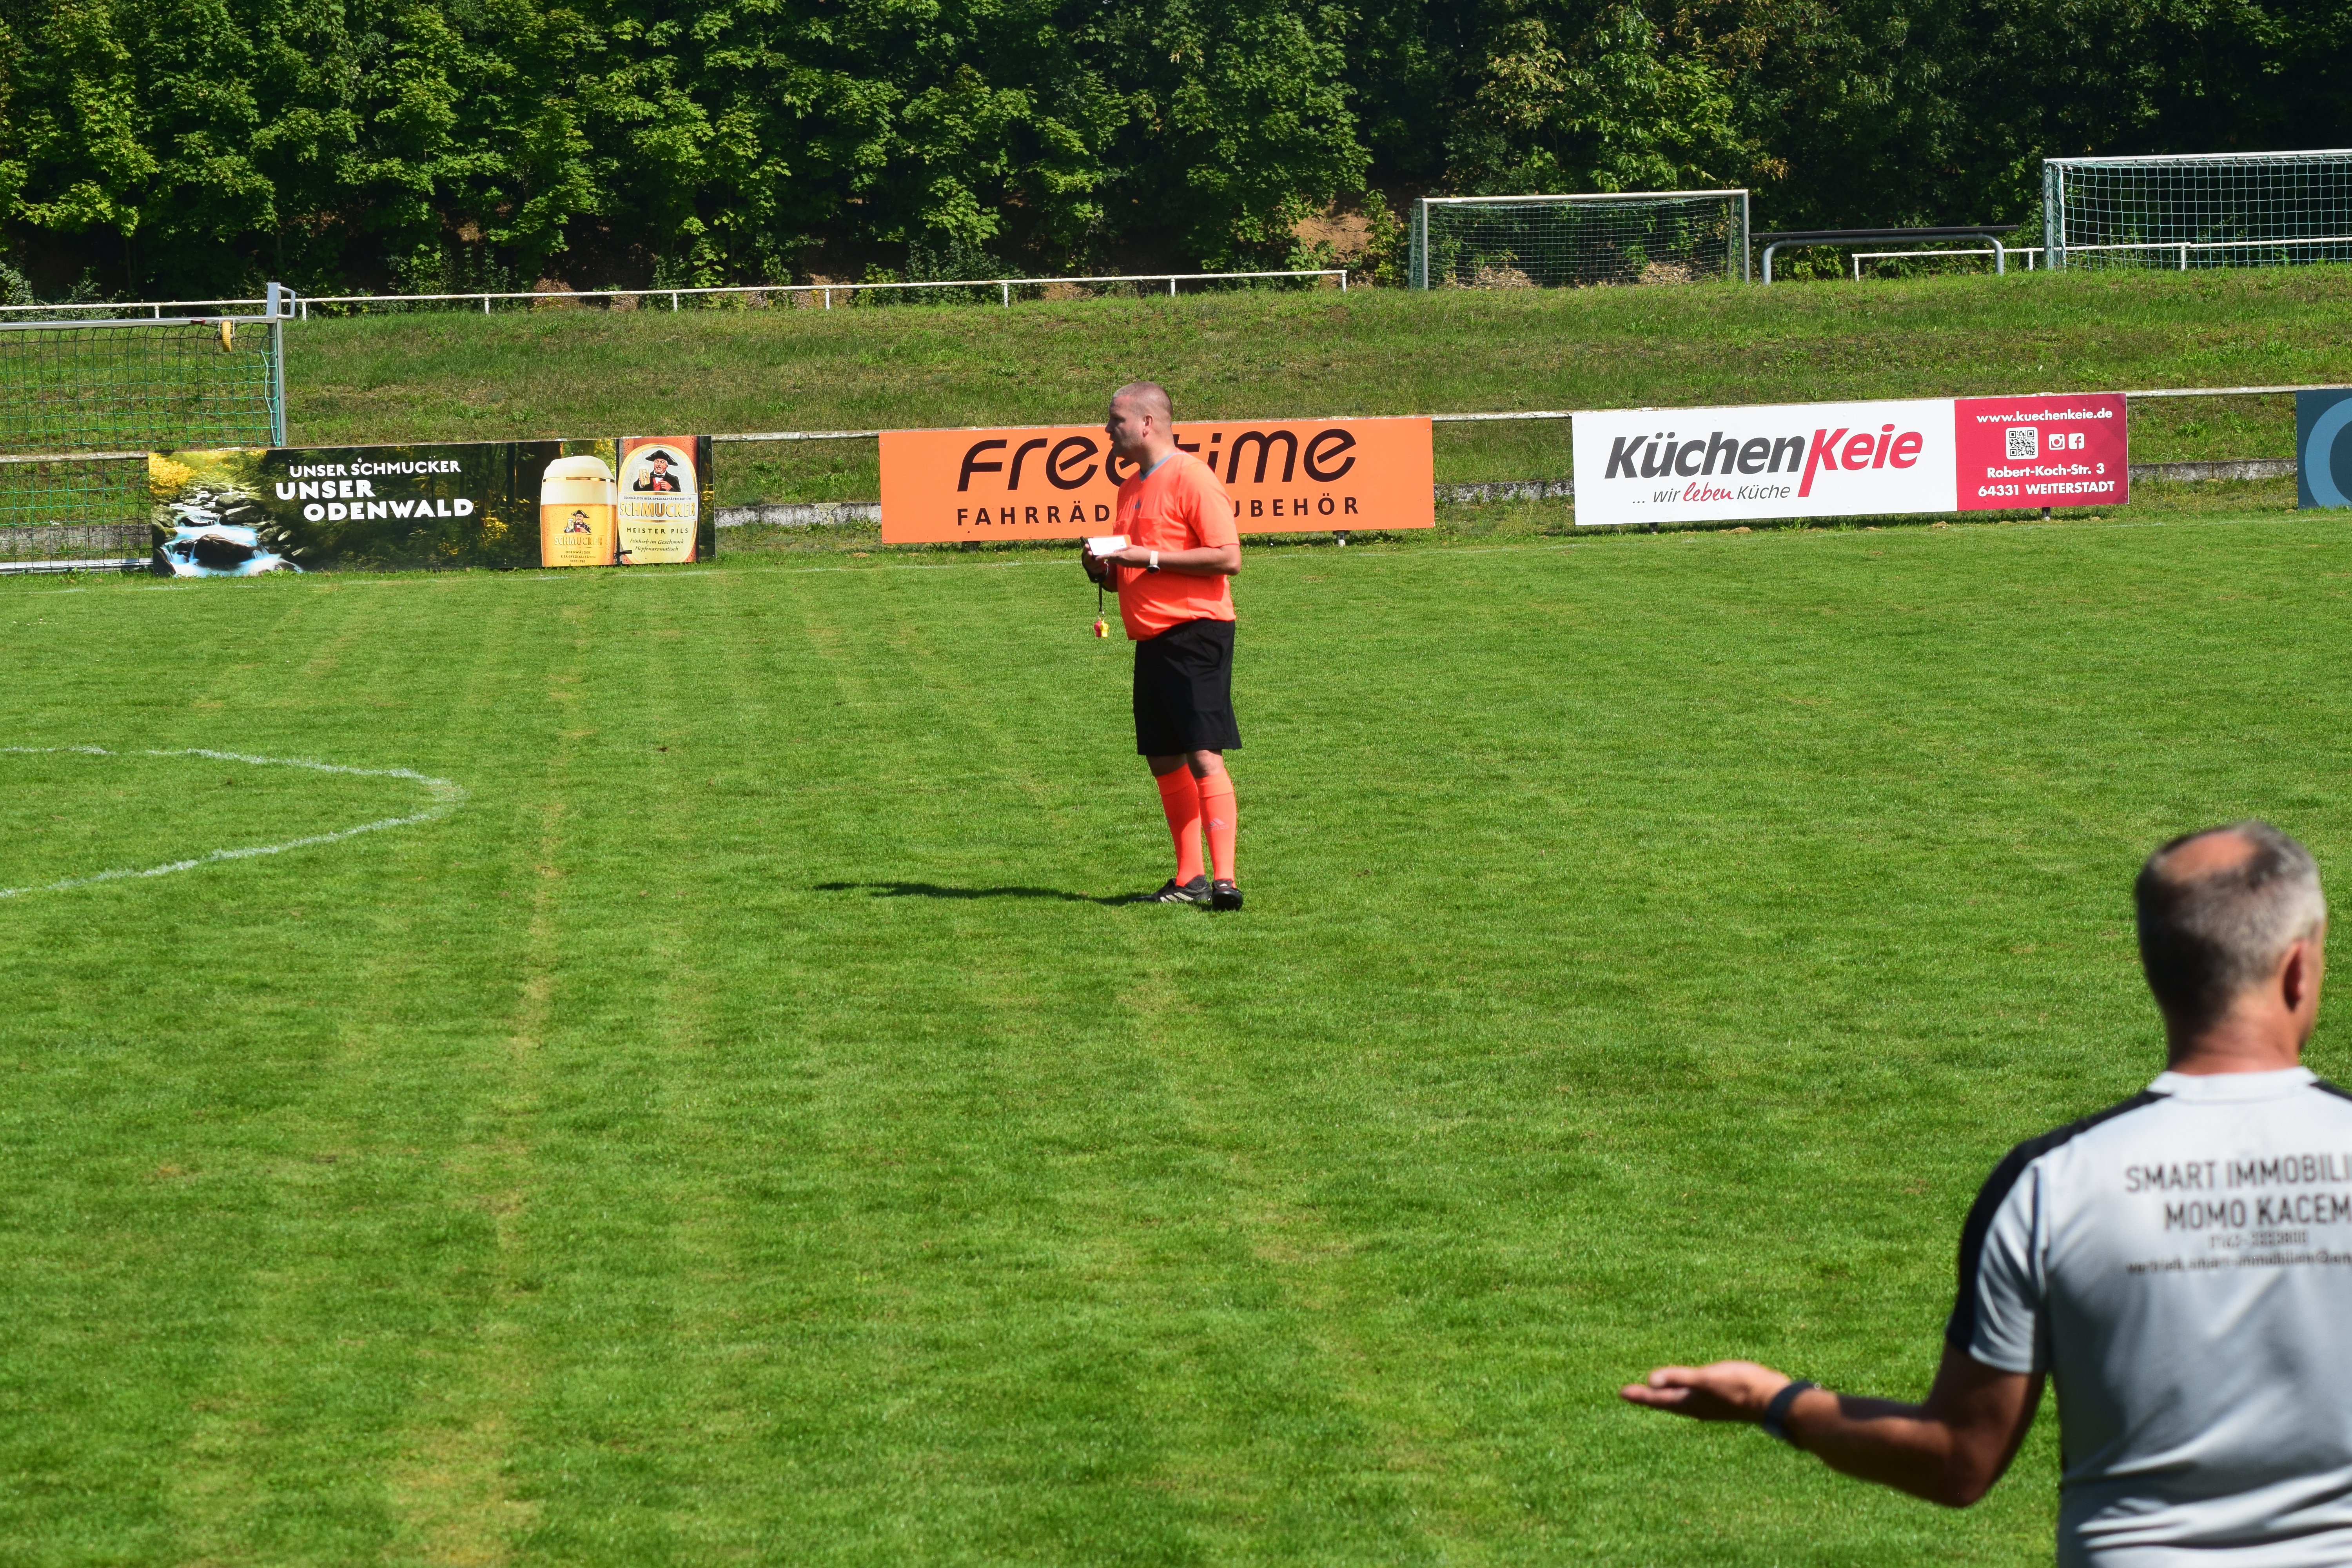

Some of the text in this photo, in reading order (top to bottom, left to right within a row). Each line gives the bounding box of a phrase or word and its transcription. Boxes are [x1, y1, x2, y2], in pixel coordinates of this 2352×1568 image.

[1976, 407, 2112, 423] www.kuechenkeie.de
[290, 461, 461, 478] UNSER SCHMUCKER
[1987, 463, 2105, 478] Robert-Koch-Str. 3
[276, 479, 376, 500] UNSER
[1654, 488, 1681, 503] wir
[1683, 482, 1734, 501] leben
[1737, 485, 1791, 500] Küche
[1978, 481, 2115, 497] 64331 WEITERSTADT
[303, 499, 474, 521] ODENWALD
[620, 502, 695, 517] SCHMUCKER
[554, 536, 602, 546] SCHMUCKER
[2125, 1154, 2352, 1193] SMART IMMOBILI
[2164, 1193, 2352, 1230] MOMO KACEM
